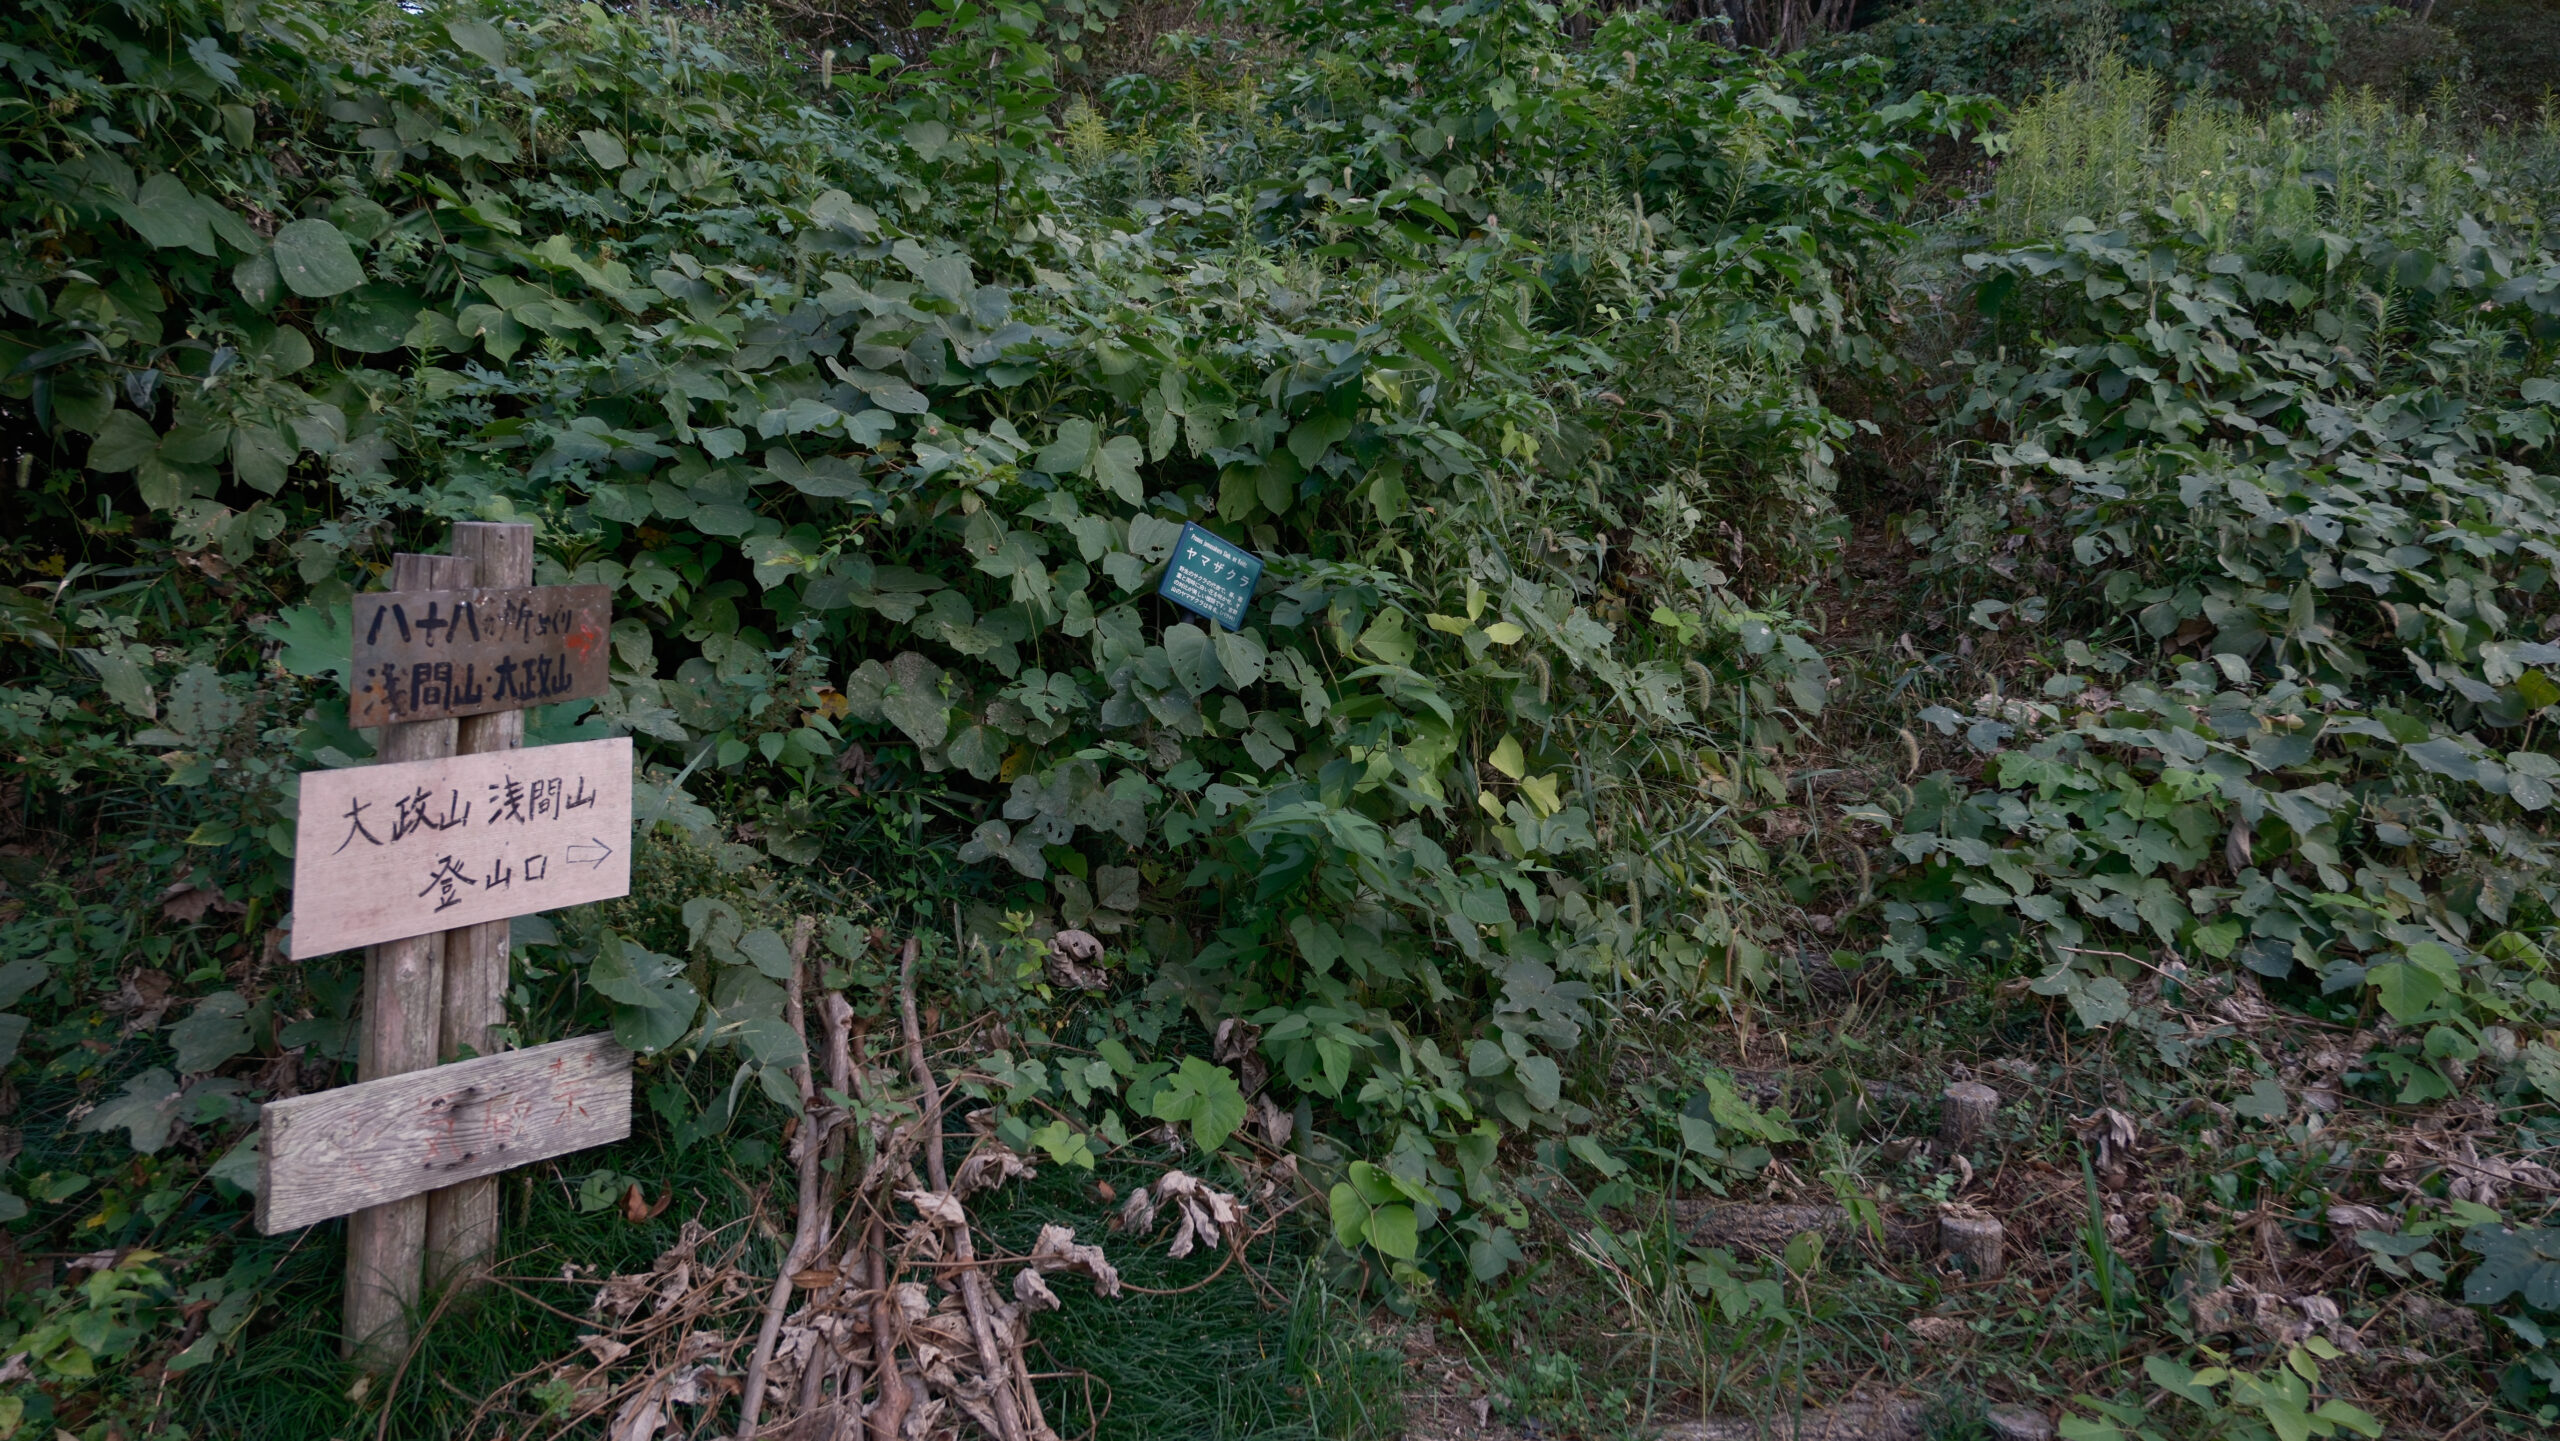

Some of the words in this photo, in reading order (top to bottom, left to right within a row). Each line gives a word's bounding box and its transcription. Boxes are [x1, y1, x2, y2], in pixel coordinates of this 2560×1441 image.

[1186, 547, 1249, 587] ヤマザクラ
[332, 786, 472, 855] 大政山
[488, 774, 596, 825] 浅間山
[418, 854, 547, 914] 登山口
